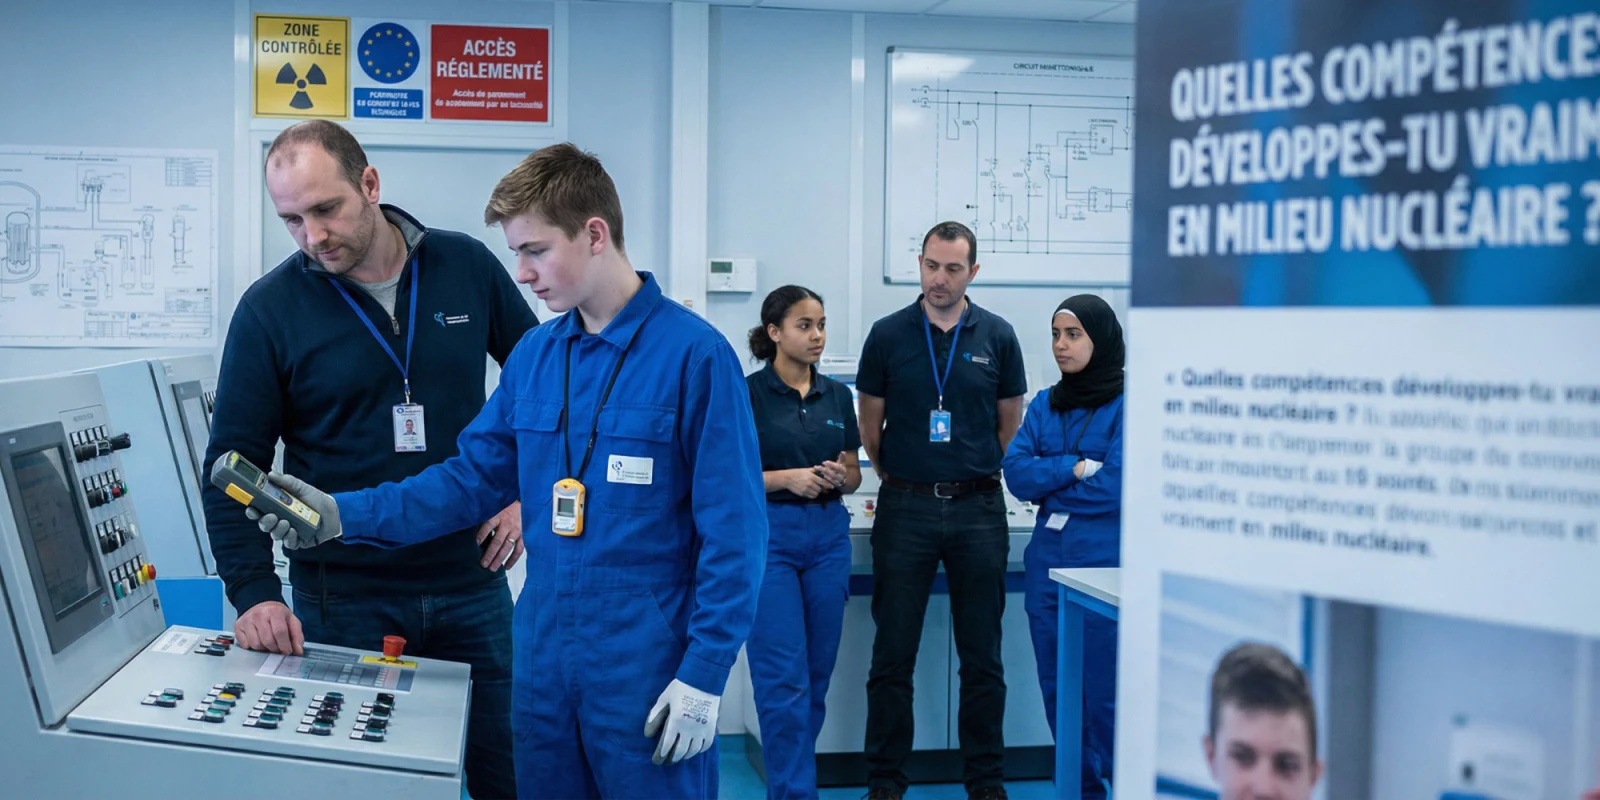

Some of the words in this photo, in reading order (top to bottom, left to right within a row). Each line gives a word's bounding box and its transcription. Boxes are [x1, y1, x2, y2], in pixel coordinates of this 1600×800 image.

[284, 23, 320, 37] ZONE
[261, 40, 342, 56] CONTRÔLÉE
[463, 37, 516, 58] ACCÈS
[436, 59, 544, 81] RÉGLEMENTÉ
[1170, 51, 1315, 122] QUELLES
[1321, 12, 1600, 104] COMPÉTENCE
[1169, 109, 1459, 189] DÉVELOPPES-TU
[1168, 203, 1211, 257] EN
[1215, 195, 1334, 255] MILIEU
[1340, 172, 1572, 252] NUCLÉAIRE
[1181, 368, 1244, 390] Quelles
[1250, 373, 1385, 395] compétences
[1164, 398, 1184, 414] en
[1190, 396, 1240, 418] milieu
[1247, 400, 1338, 423] nucléaire
[1269, 519, 1328, 545] milieu
